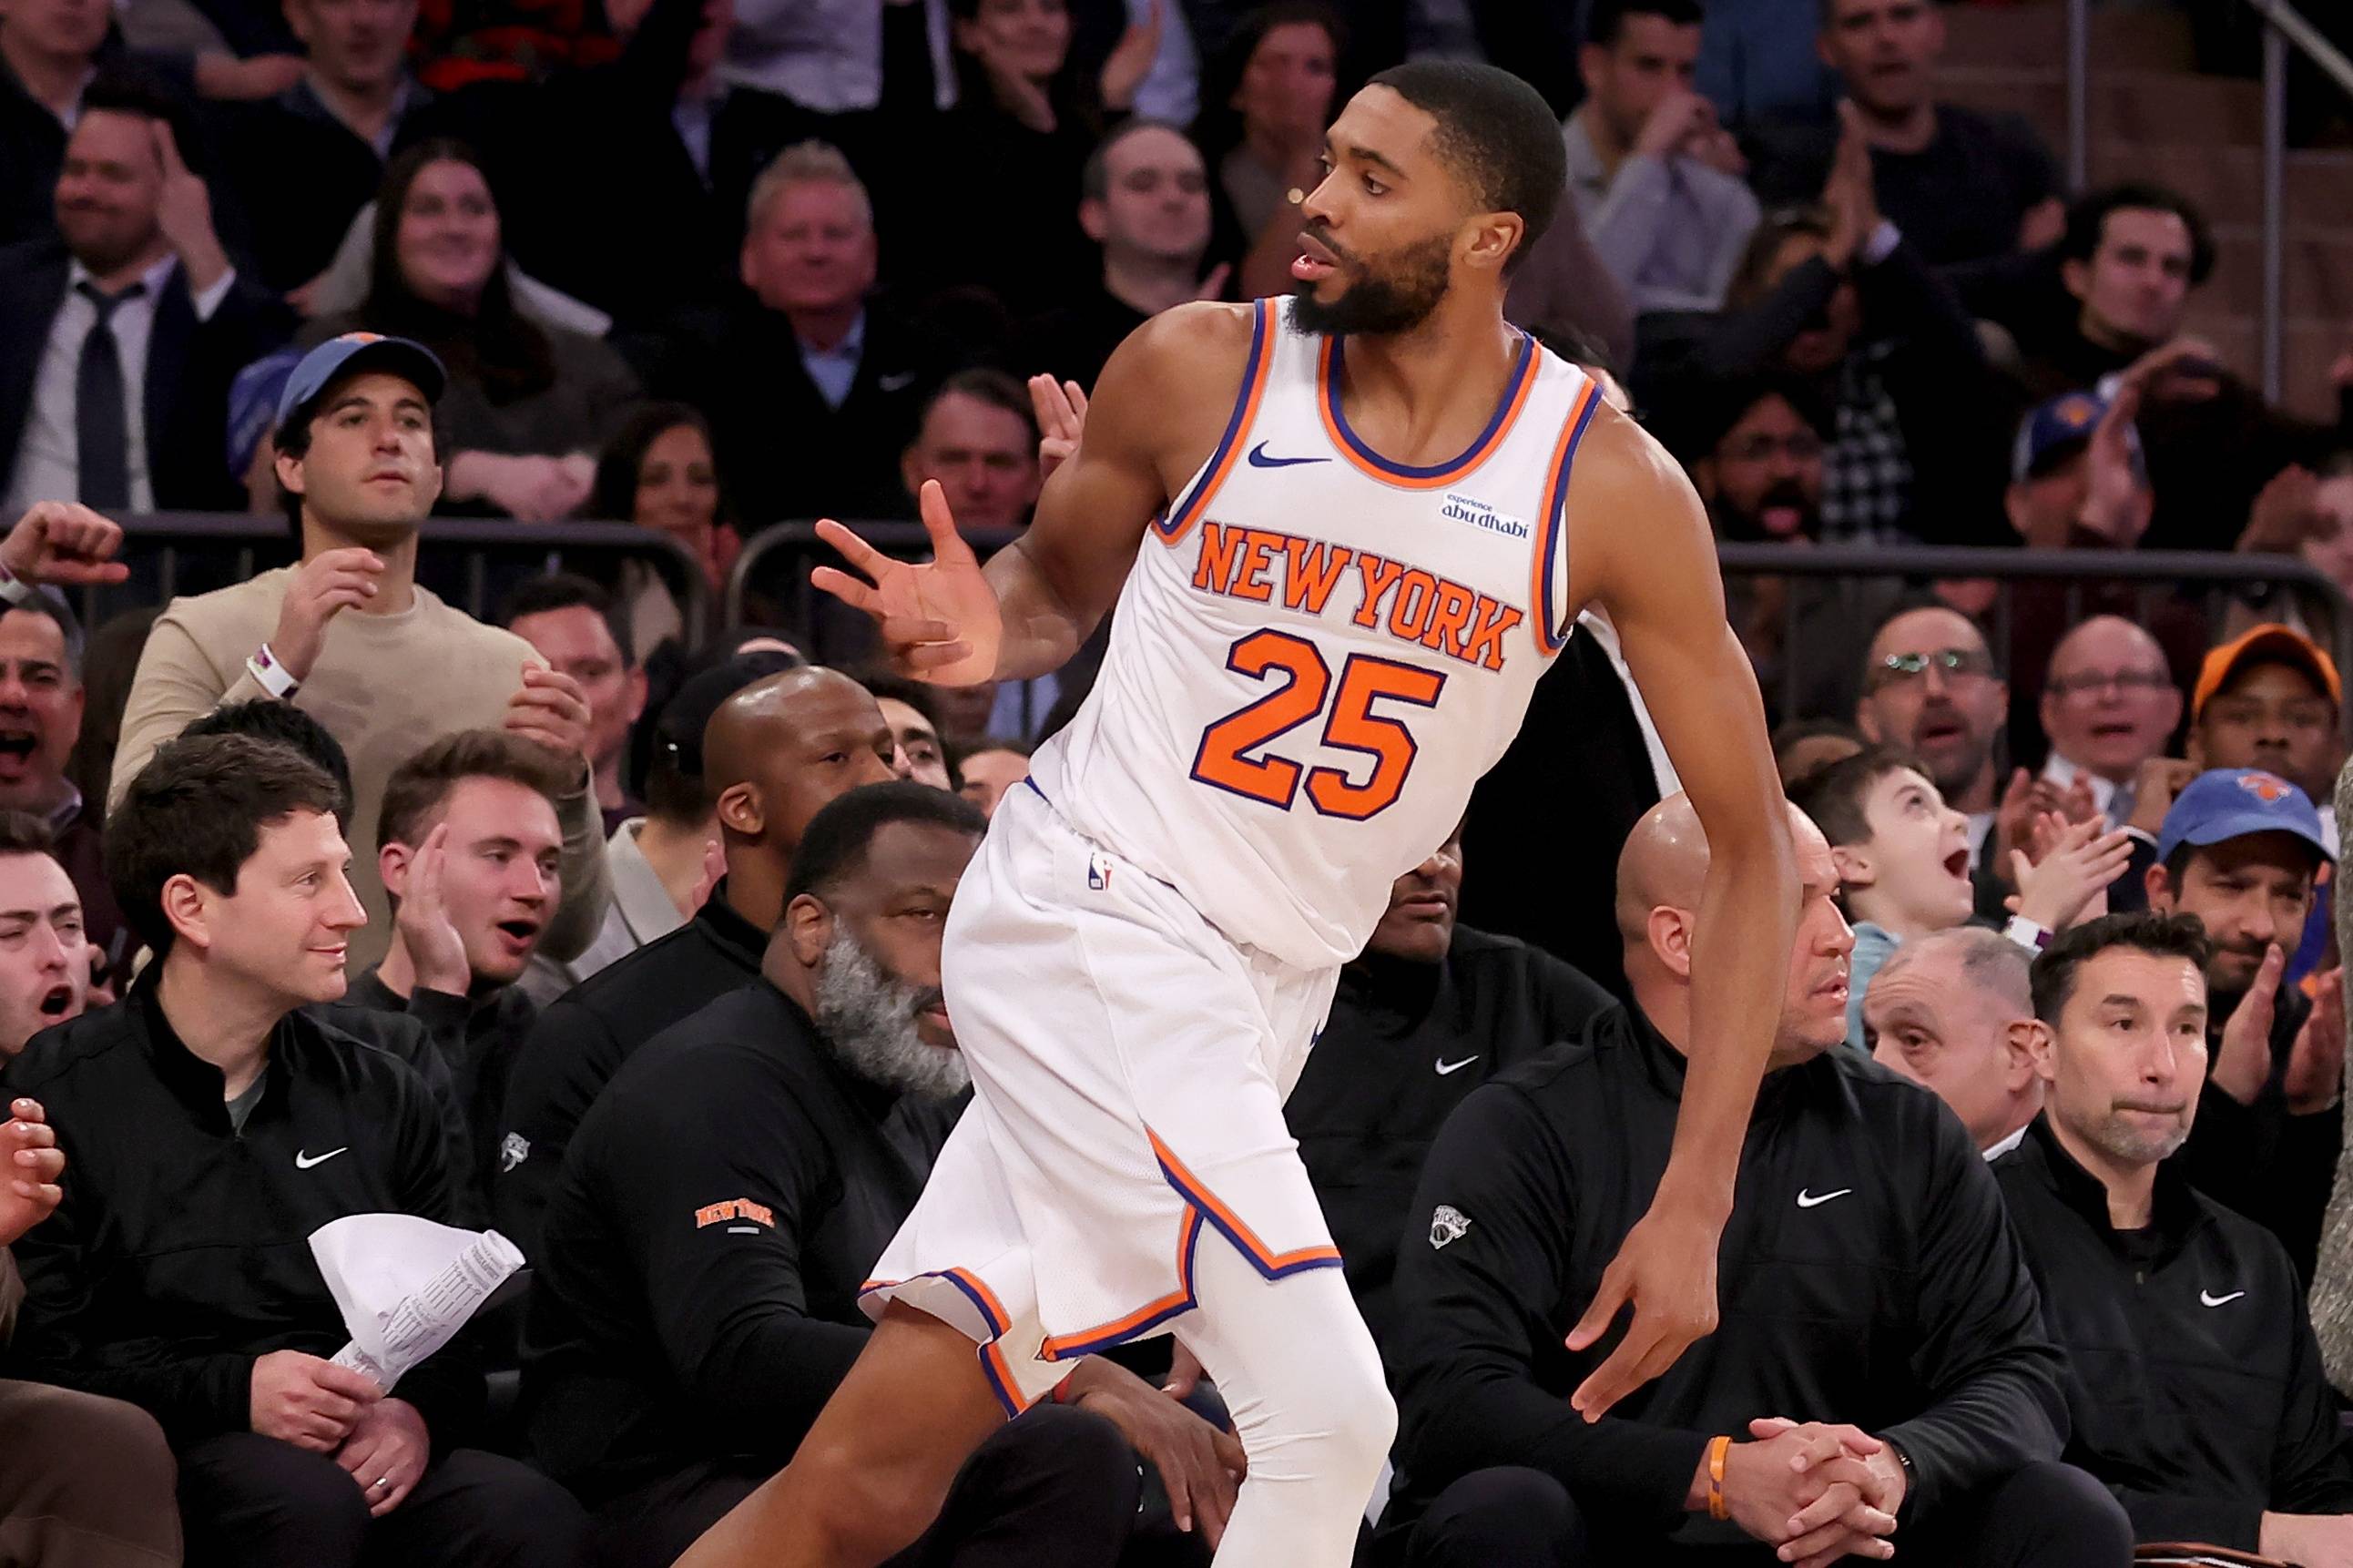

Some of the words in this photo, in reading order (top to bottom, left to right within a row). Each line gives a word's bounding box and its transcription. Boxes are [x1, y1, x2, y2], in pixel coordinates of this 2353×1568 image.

[1441, 504, 1476, 524] abu
[1478, 514, 1530, 539] dhabi
[1447, 494, 1492, 512] experience
[1192, 520, 1353, 615] NEW
[1352, 552, 1524, 672] YORK
[1190, 627, 1448, 821] 25
